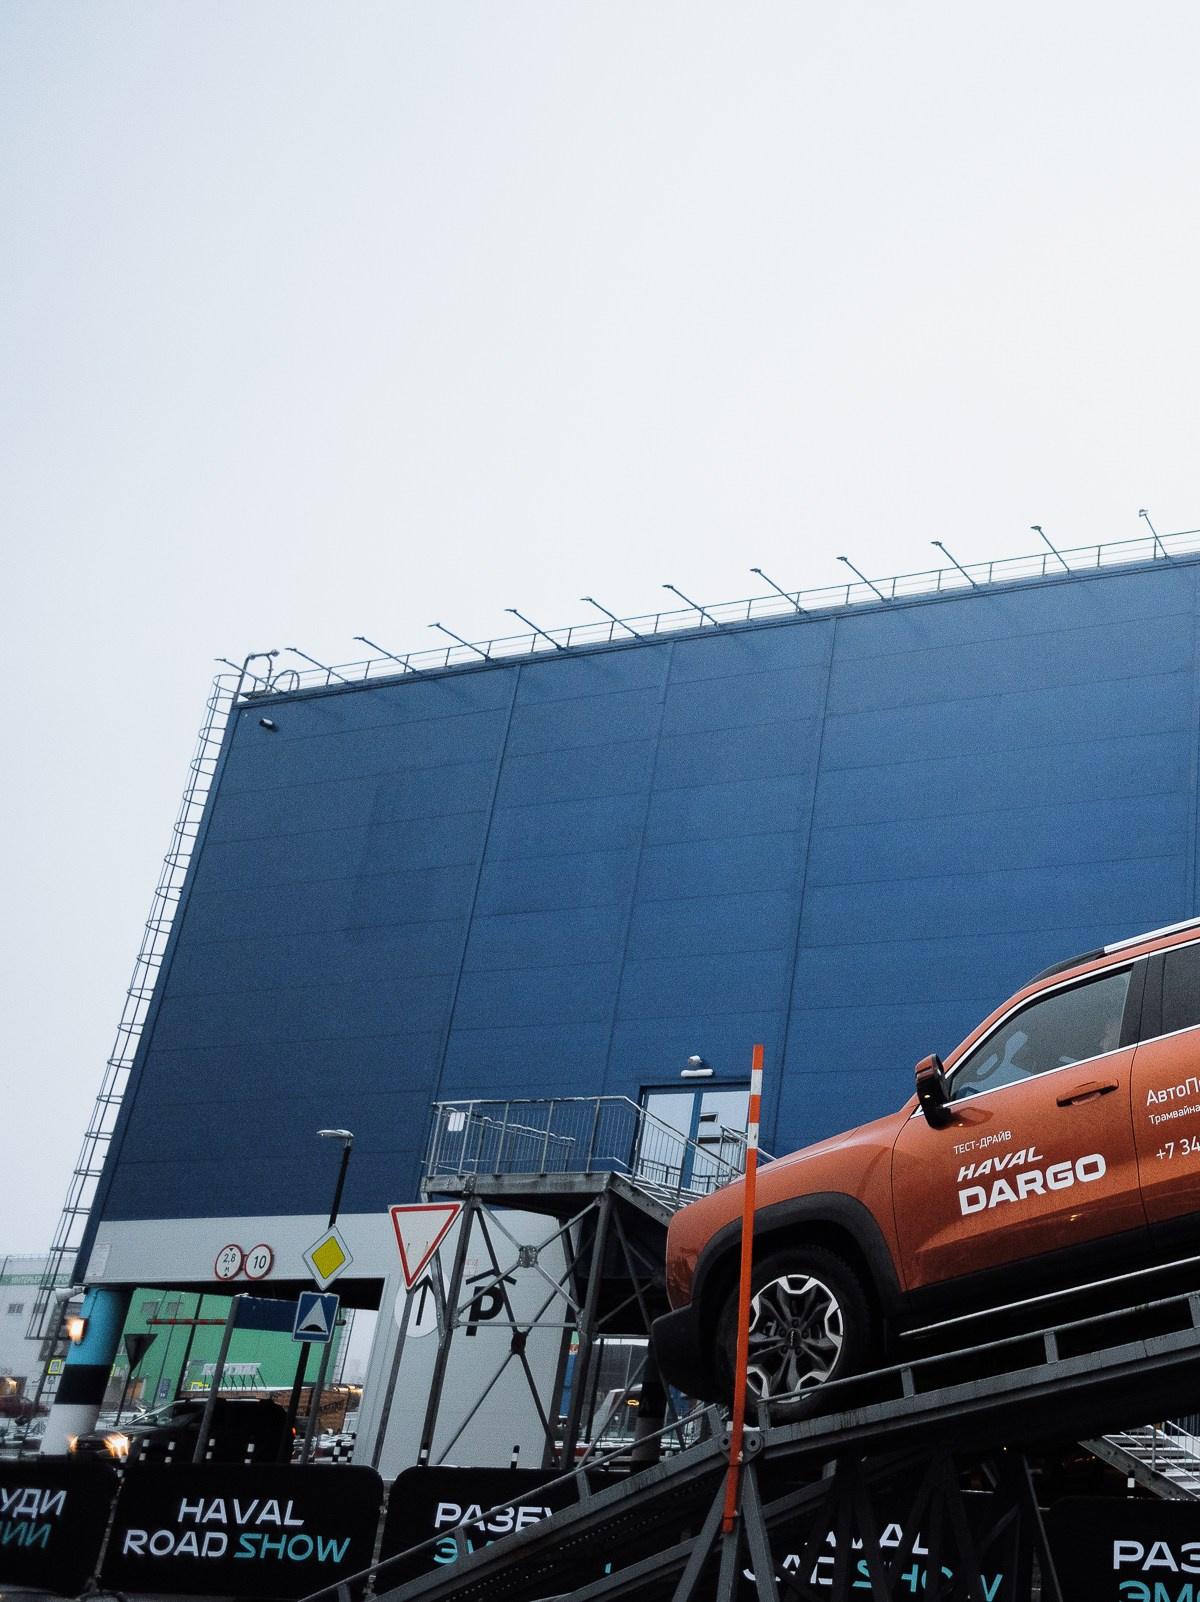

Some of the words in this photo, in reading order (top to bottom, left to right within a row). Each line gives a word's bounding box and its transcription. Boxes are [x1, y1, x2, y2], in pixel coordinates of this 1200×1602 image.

[953, 1130, 1012, 1155] ТЕСТ-ДРАЙВ
[1156, 1142, 1175, 1160] +7
[957, 1146, 1044, 1183] HAVAL
[958, 1153, 1107, 1216] DARGO
[223, 1253, 236, 1265] 2,8
[253, 1255, 267, 1270] 10
[465, 1286, 505, 1337] P
[177, 1497, 305, 1526] HAVAL
[122, 1529, 228, 1557] ROAD
[233, 1532, 351, 1563] SHOW
